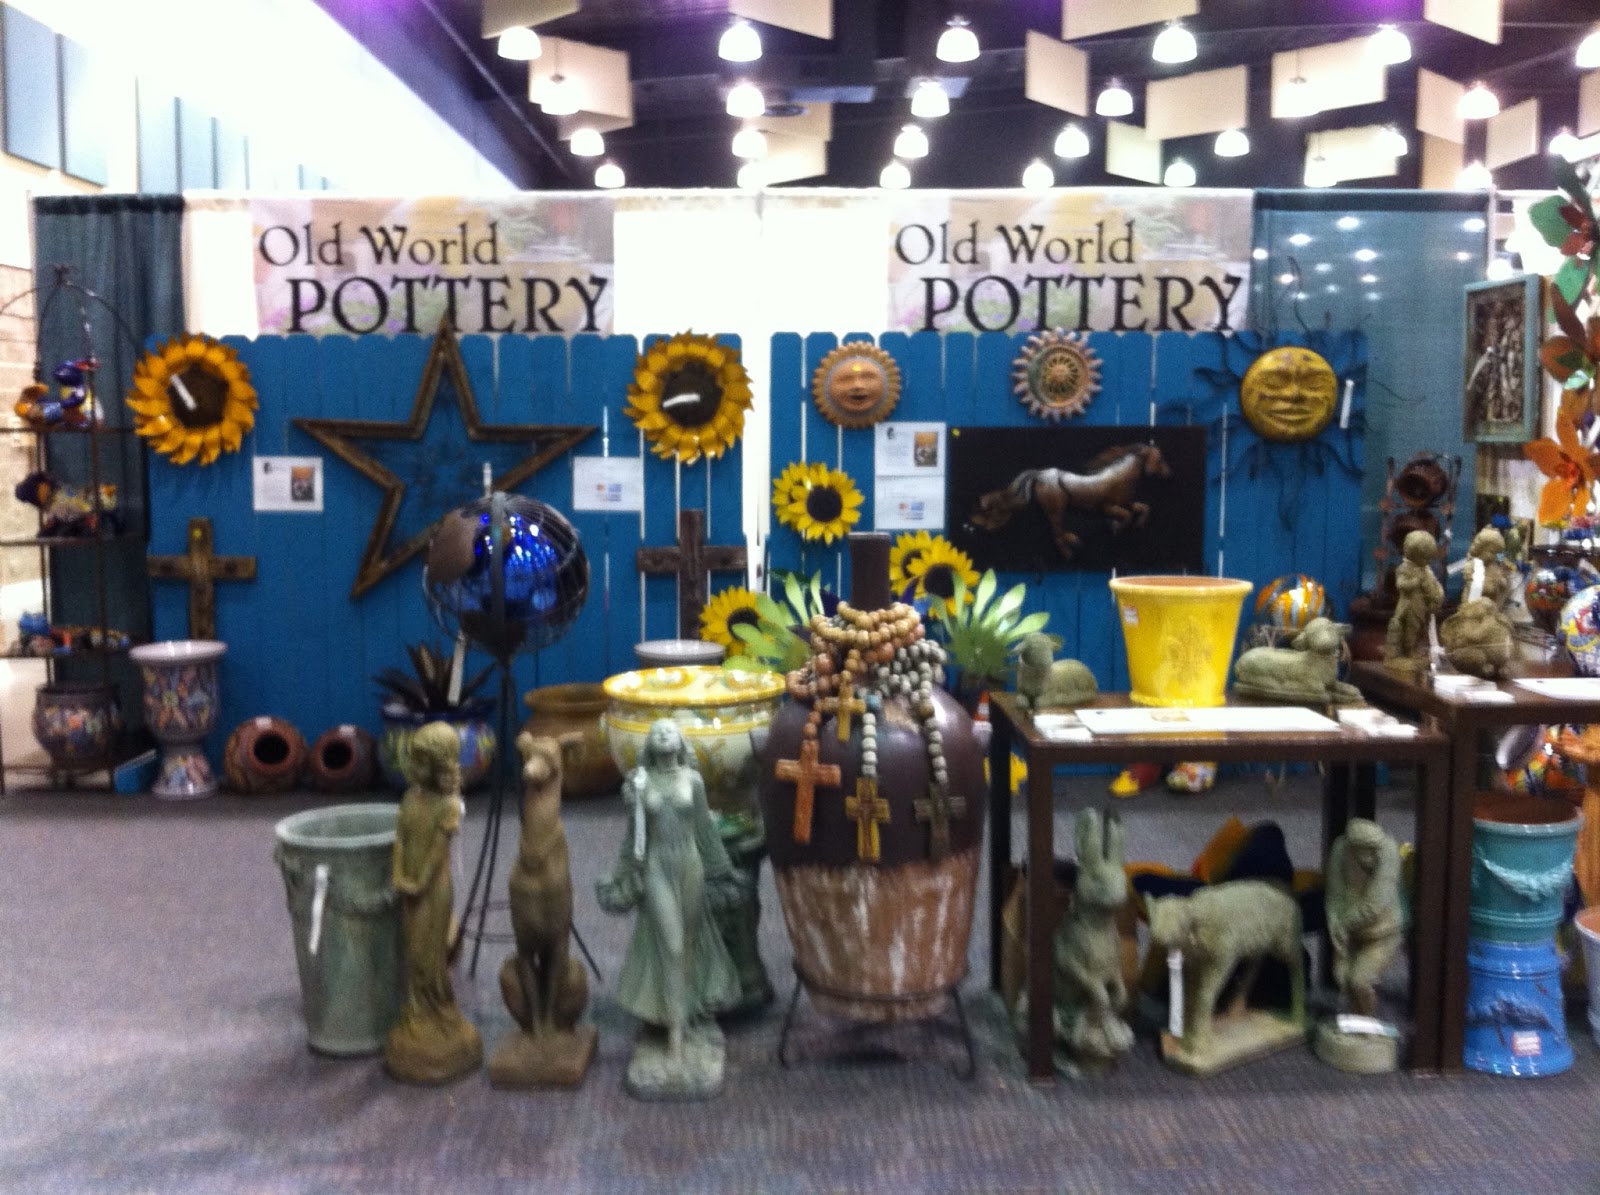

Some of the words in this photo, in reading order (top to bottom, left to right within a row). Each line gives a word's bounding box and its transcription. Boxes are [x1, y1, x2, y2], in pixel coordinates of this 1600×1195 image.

[259, 221, 343, 267] Old
[359, 221, 500, 267] World
[895, 220, 980, 265] Old
[996, 220, 1137, 265] World
[286, 275, 608, 334] POTTERY
[920, 274, 1242, 332] POTTERY
